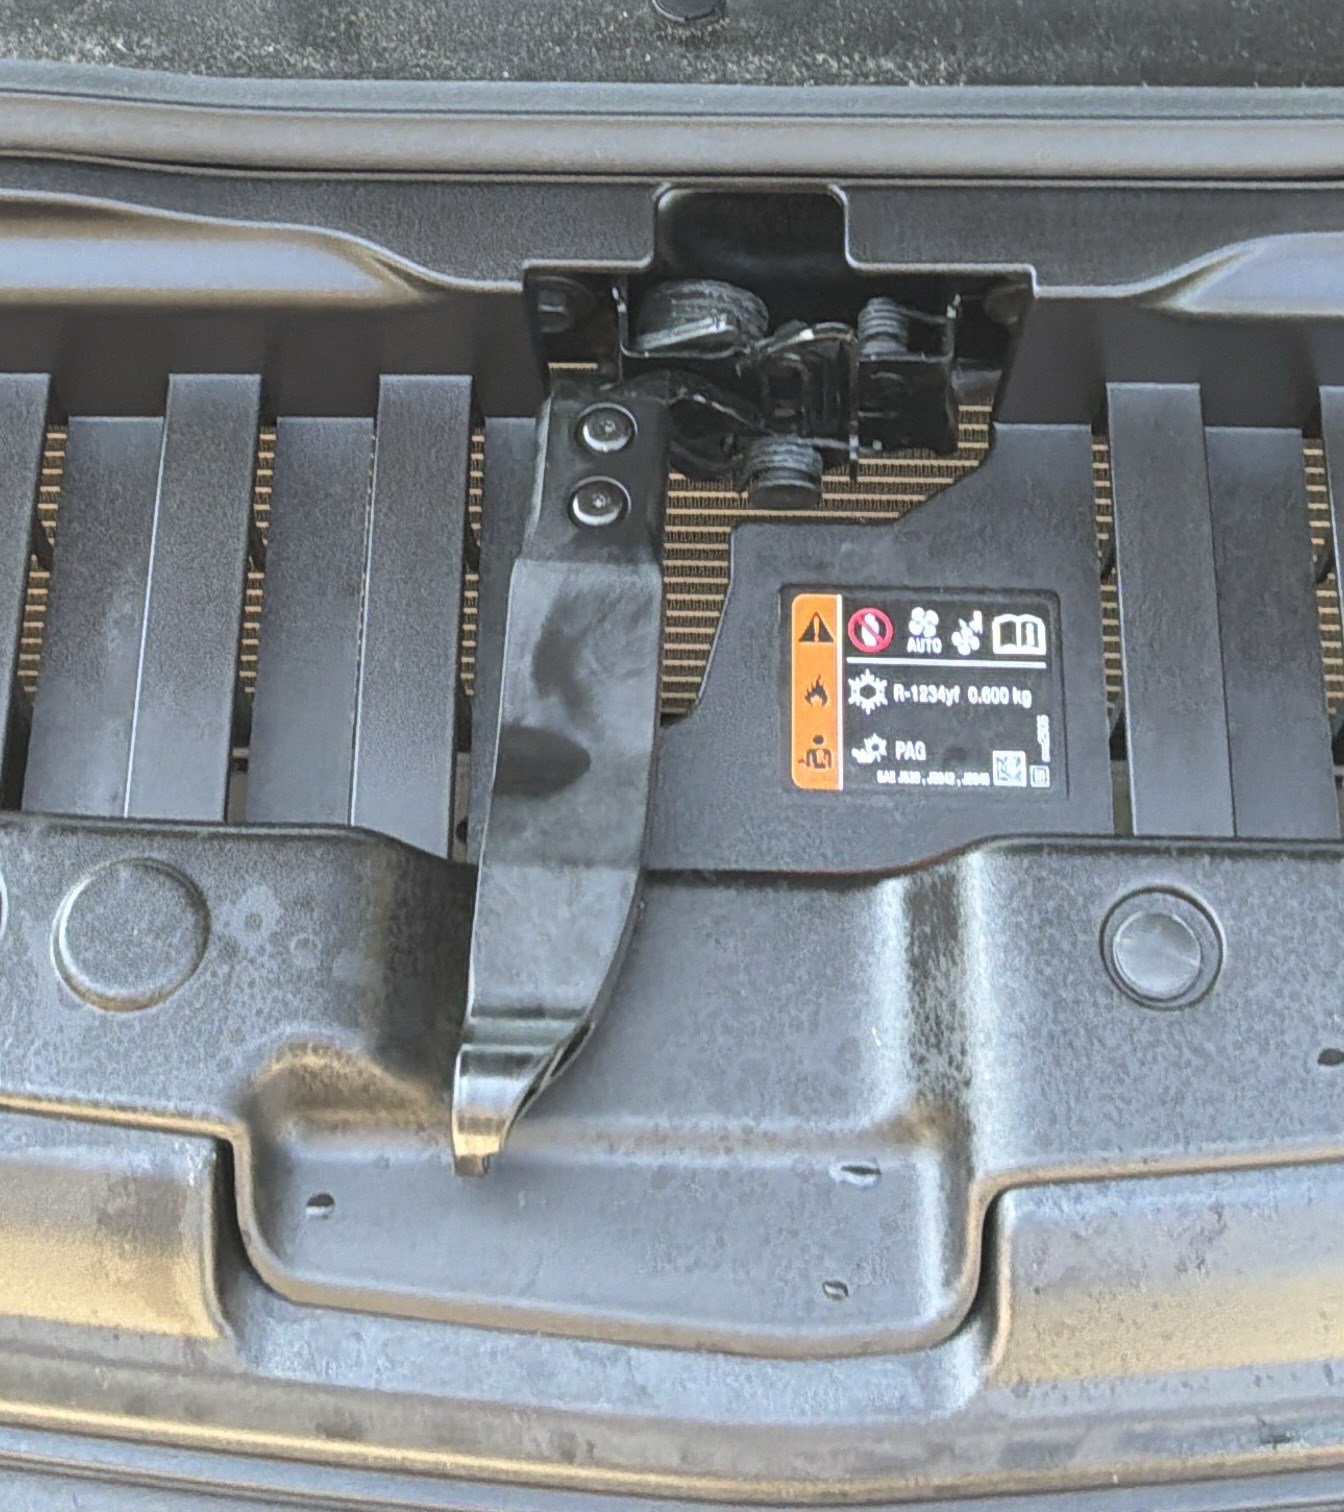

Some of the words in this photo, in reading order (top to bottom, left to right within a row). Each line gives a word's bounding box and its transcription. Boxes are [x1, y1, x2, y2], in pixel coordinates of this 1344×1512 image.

[907, 638, 942, 654] AUTO
[893, 683, 961, 707] R-1234yf
[1012, 685, 1033, 709] kg
[895, 740, 927, 761] PAG
